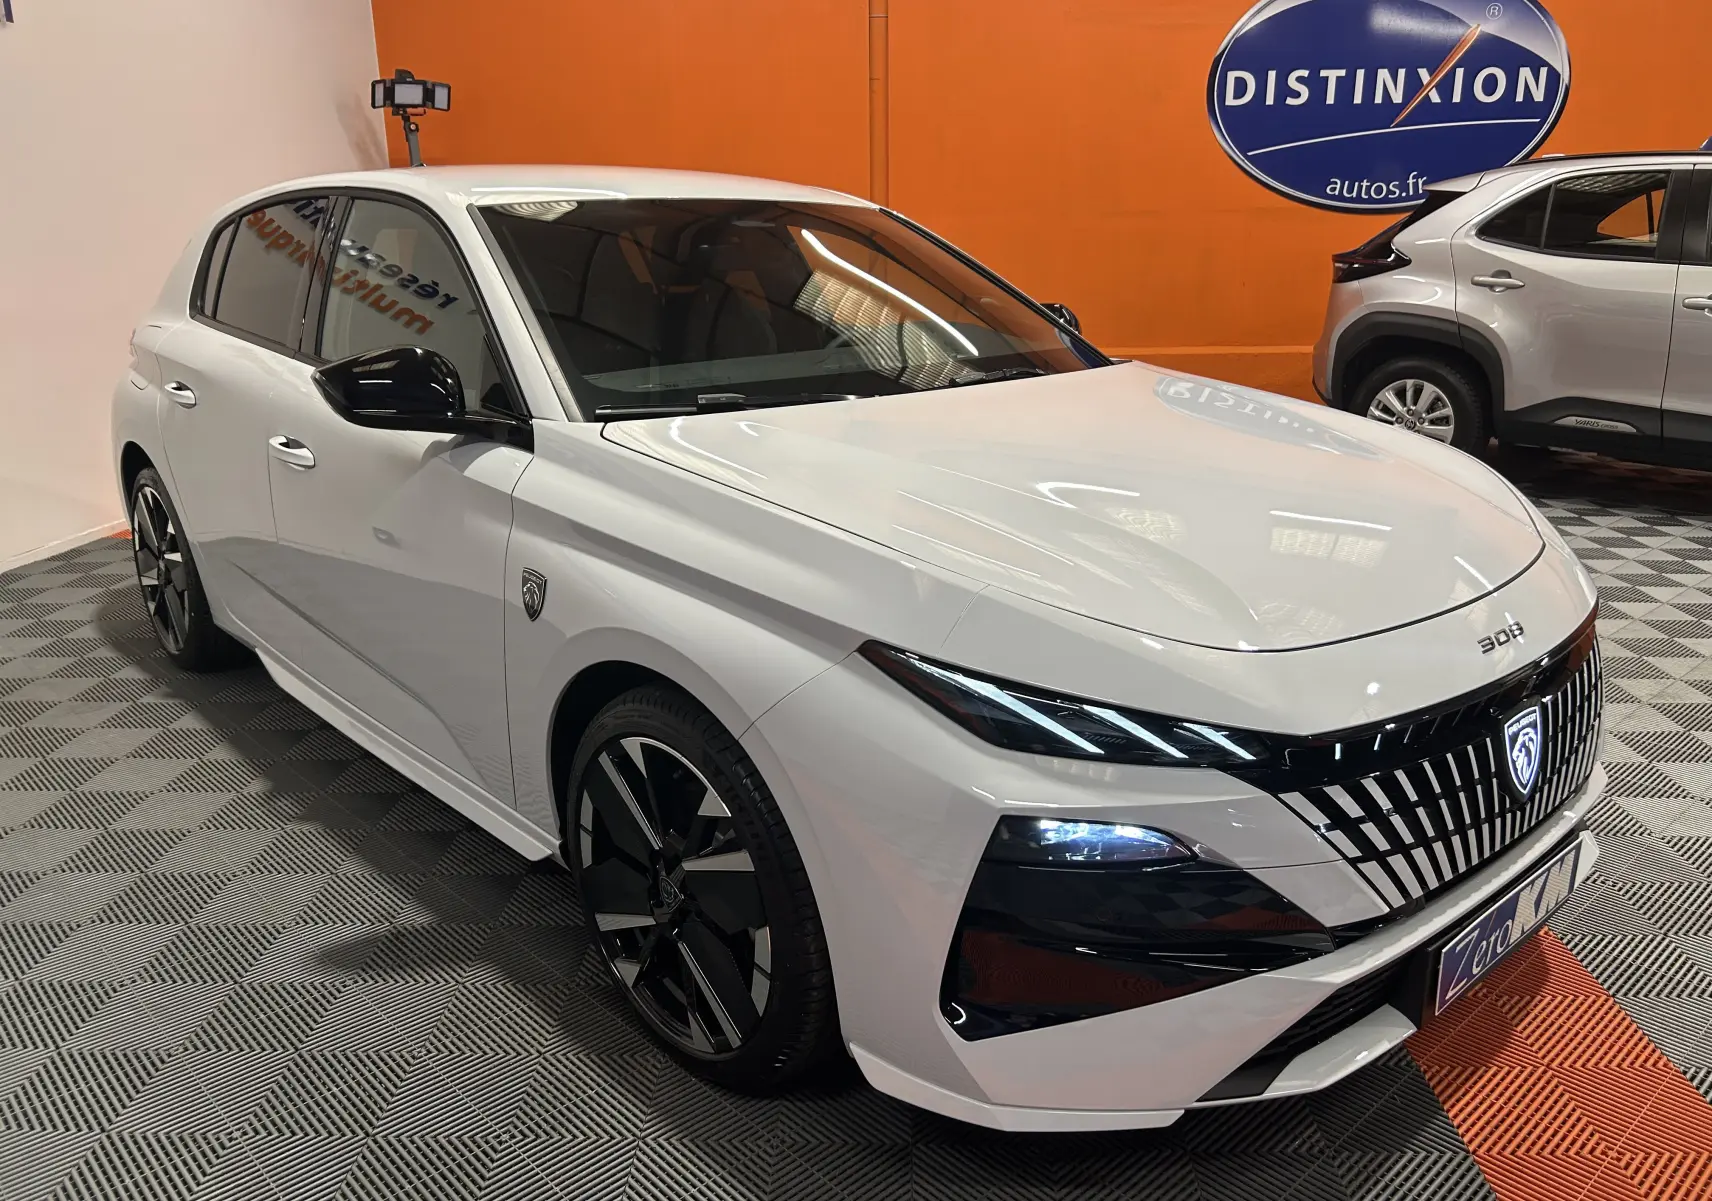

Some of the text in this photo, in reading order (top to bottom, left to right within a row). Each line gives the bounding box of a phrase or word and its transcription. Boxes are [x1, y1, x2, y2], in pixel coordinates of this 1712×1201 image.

[1224, 66, 1549, 107] DISTINXION
[1325, 171, 1428, 200] autos.fr
[1574, 419, 1600, 428] YARIS
[1477, 621, 1525, 655] 308
